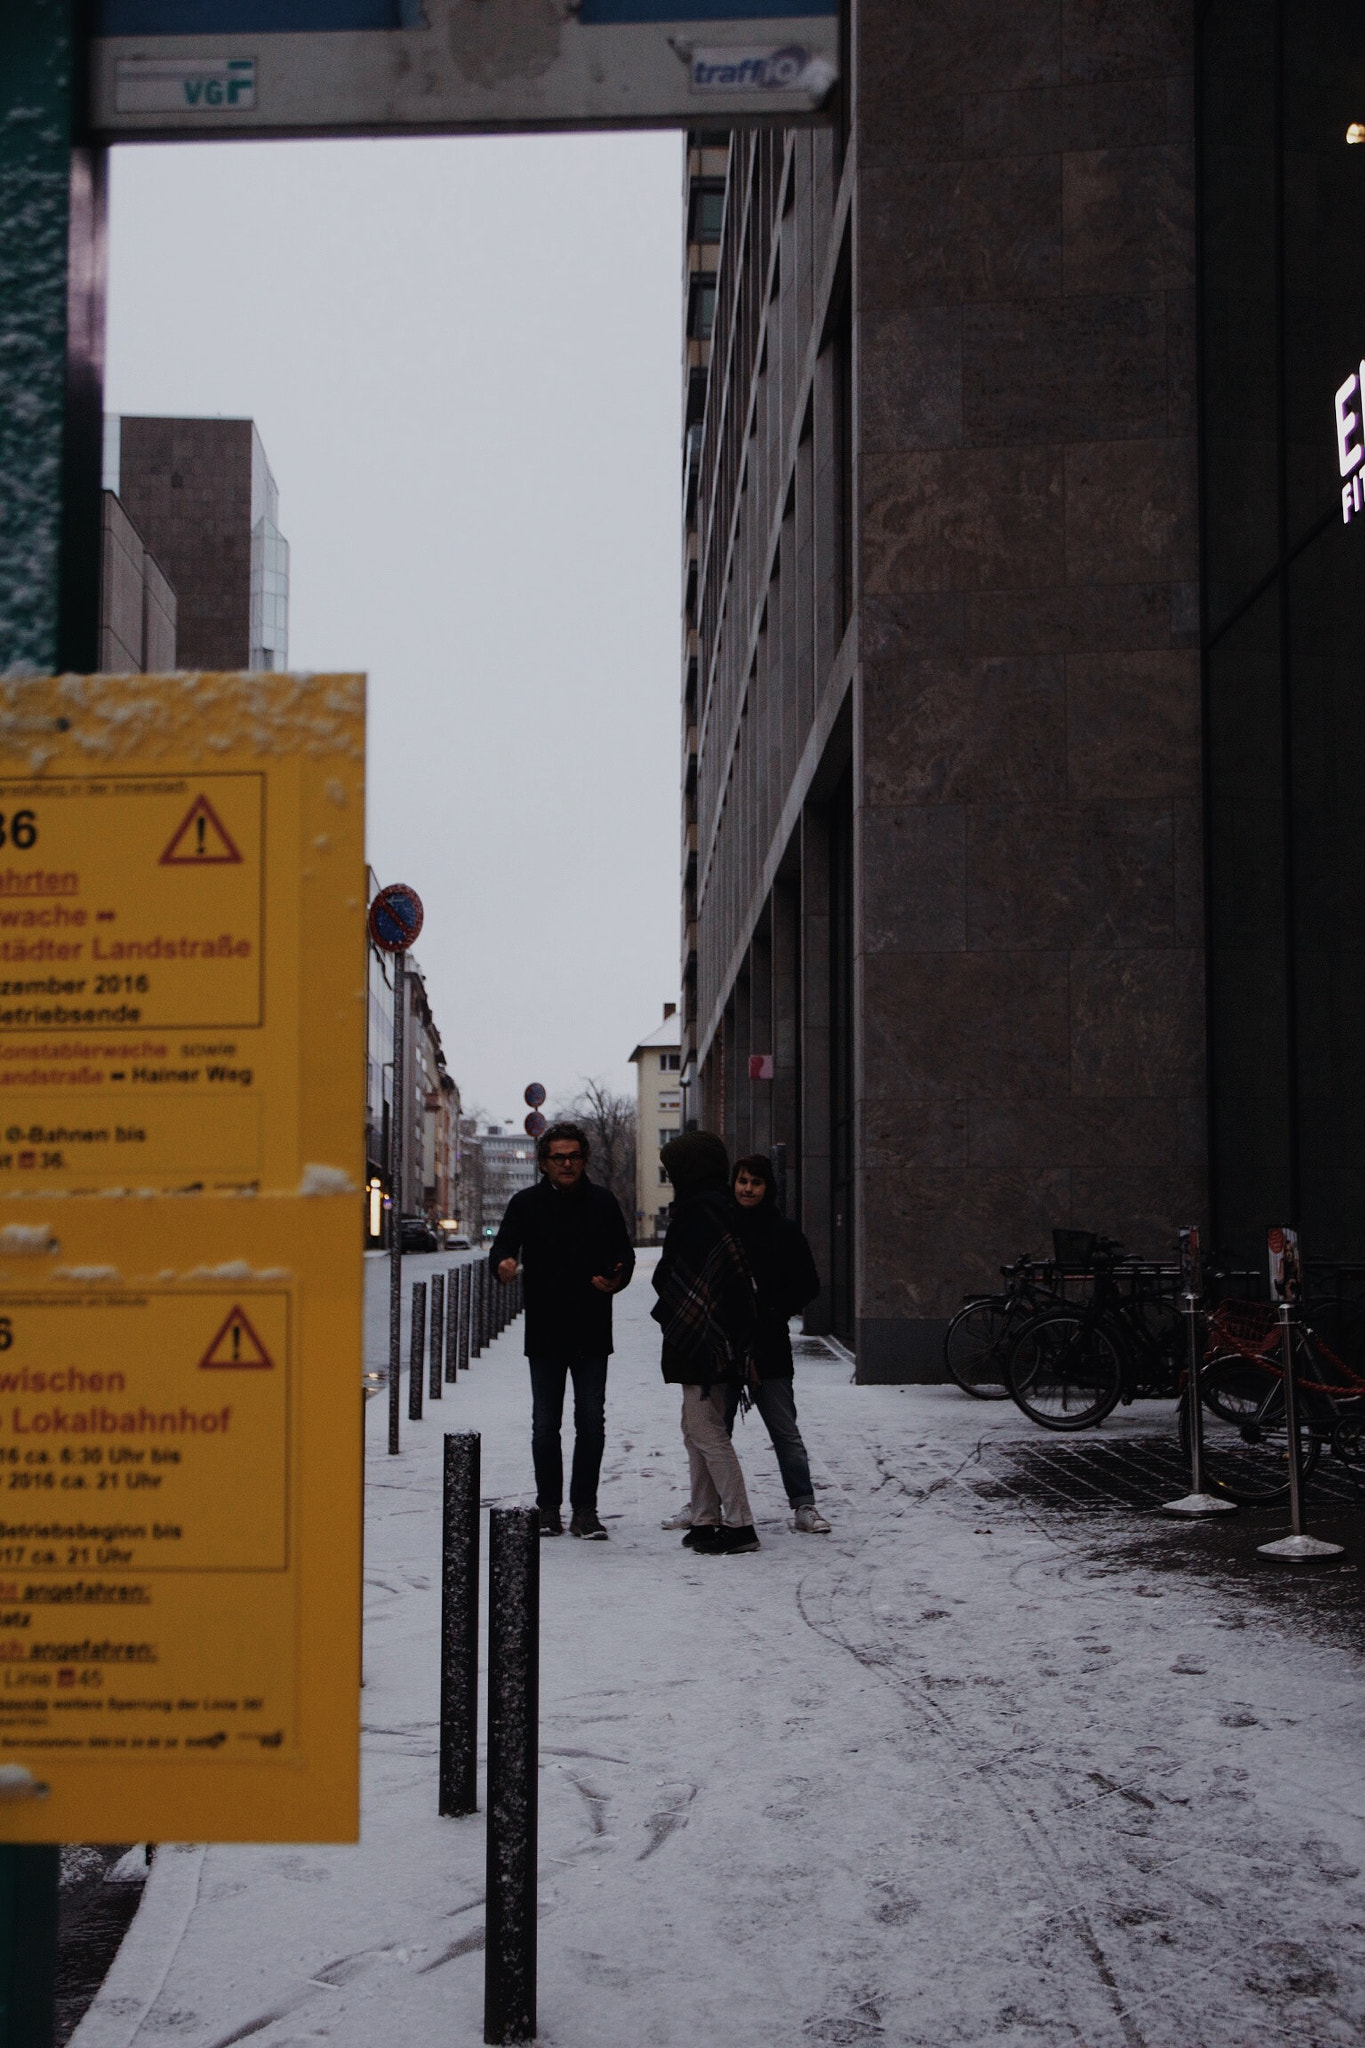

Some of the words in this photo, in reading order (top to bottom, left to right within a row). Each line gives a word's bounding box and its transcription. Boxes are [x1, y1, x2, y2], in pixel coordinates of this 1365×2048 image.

[184, 63, 253, 105] VGF
[0, 868, 79, 896] hrten
[92, 933, 251, 961] Landstraße
[95, 974, 149, 994] 2016
[0, 1003, 141, 1024] etriebsende
[12, 1405, 232, 1434] Lokalbahnhof
